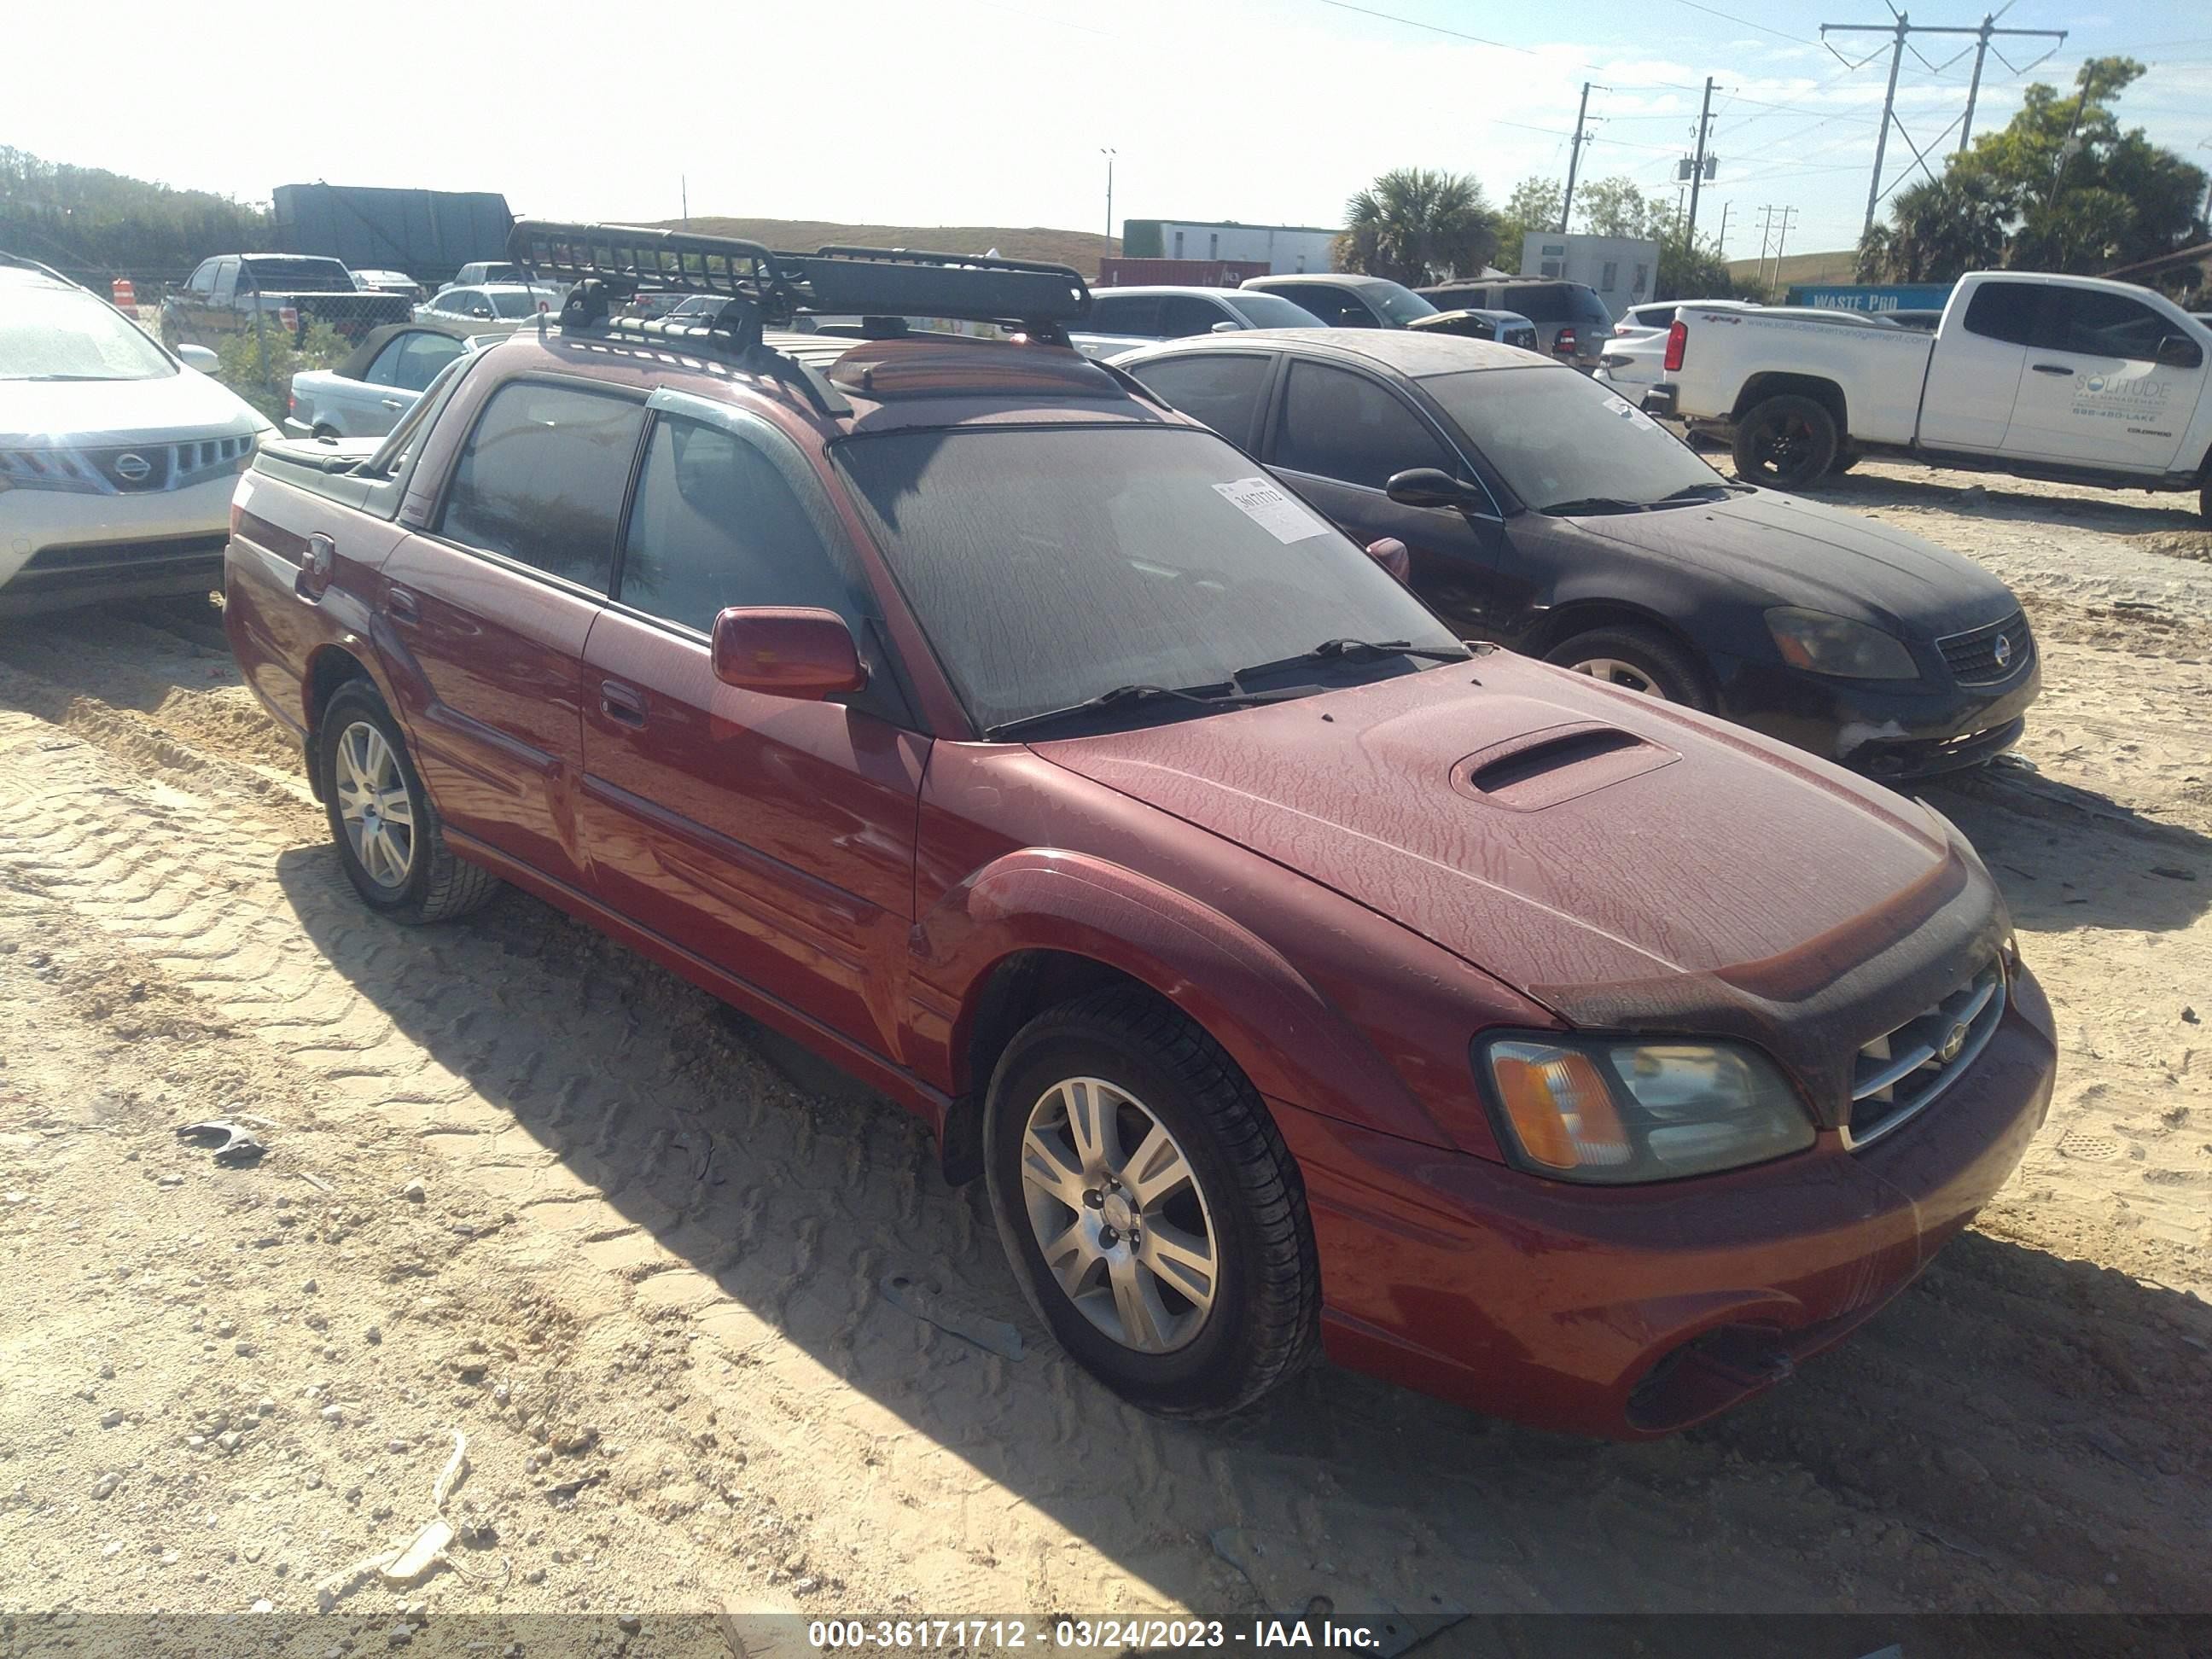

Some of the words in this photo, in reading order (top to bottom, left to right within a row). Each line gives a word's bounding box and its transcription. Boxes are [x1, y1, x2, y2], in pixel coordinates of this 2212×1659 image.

[1814, 294, 1862, 311] WASTE
[1869, 294, 1898, 312] PRO
[2075, 374, 2173, 398] SOLITUDE
[2100, 394, 2167, 406] MANAGEMENT
[1234, 490, 1283, 509] 36171712
